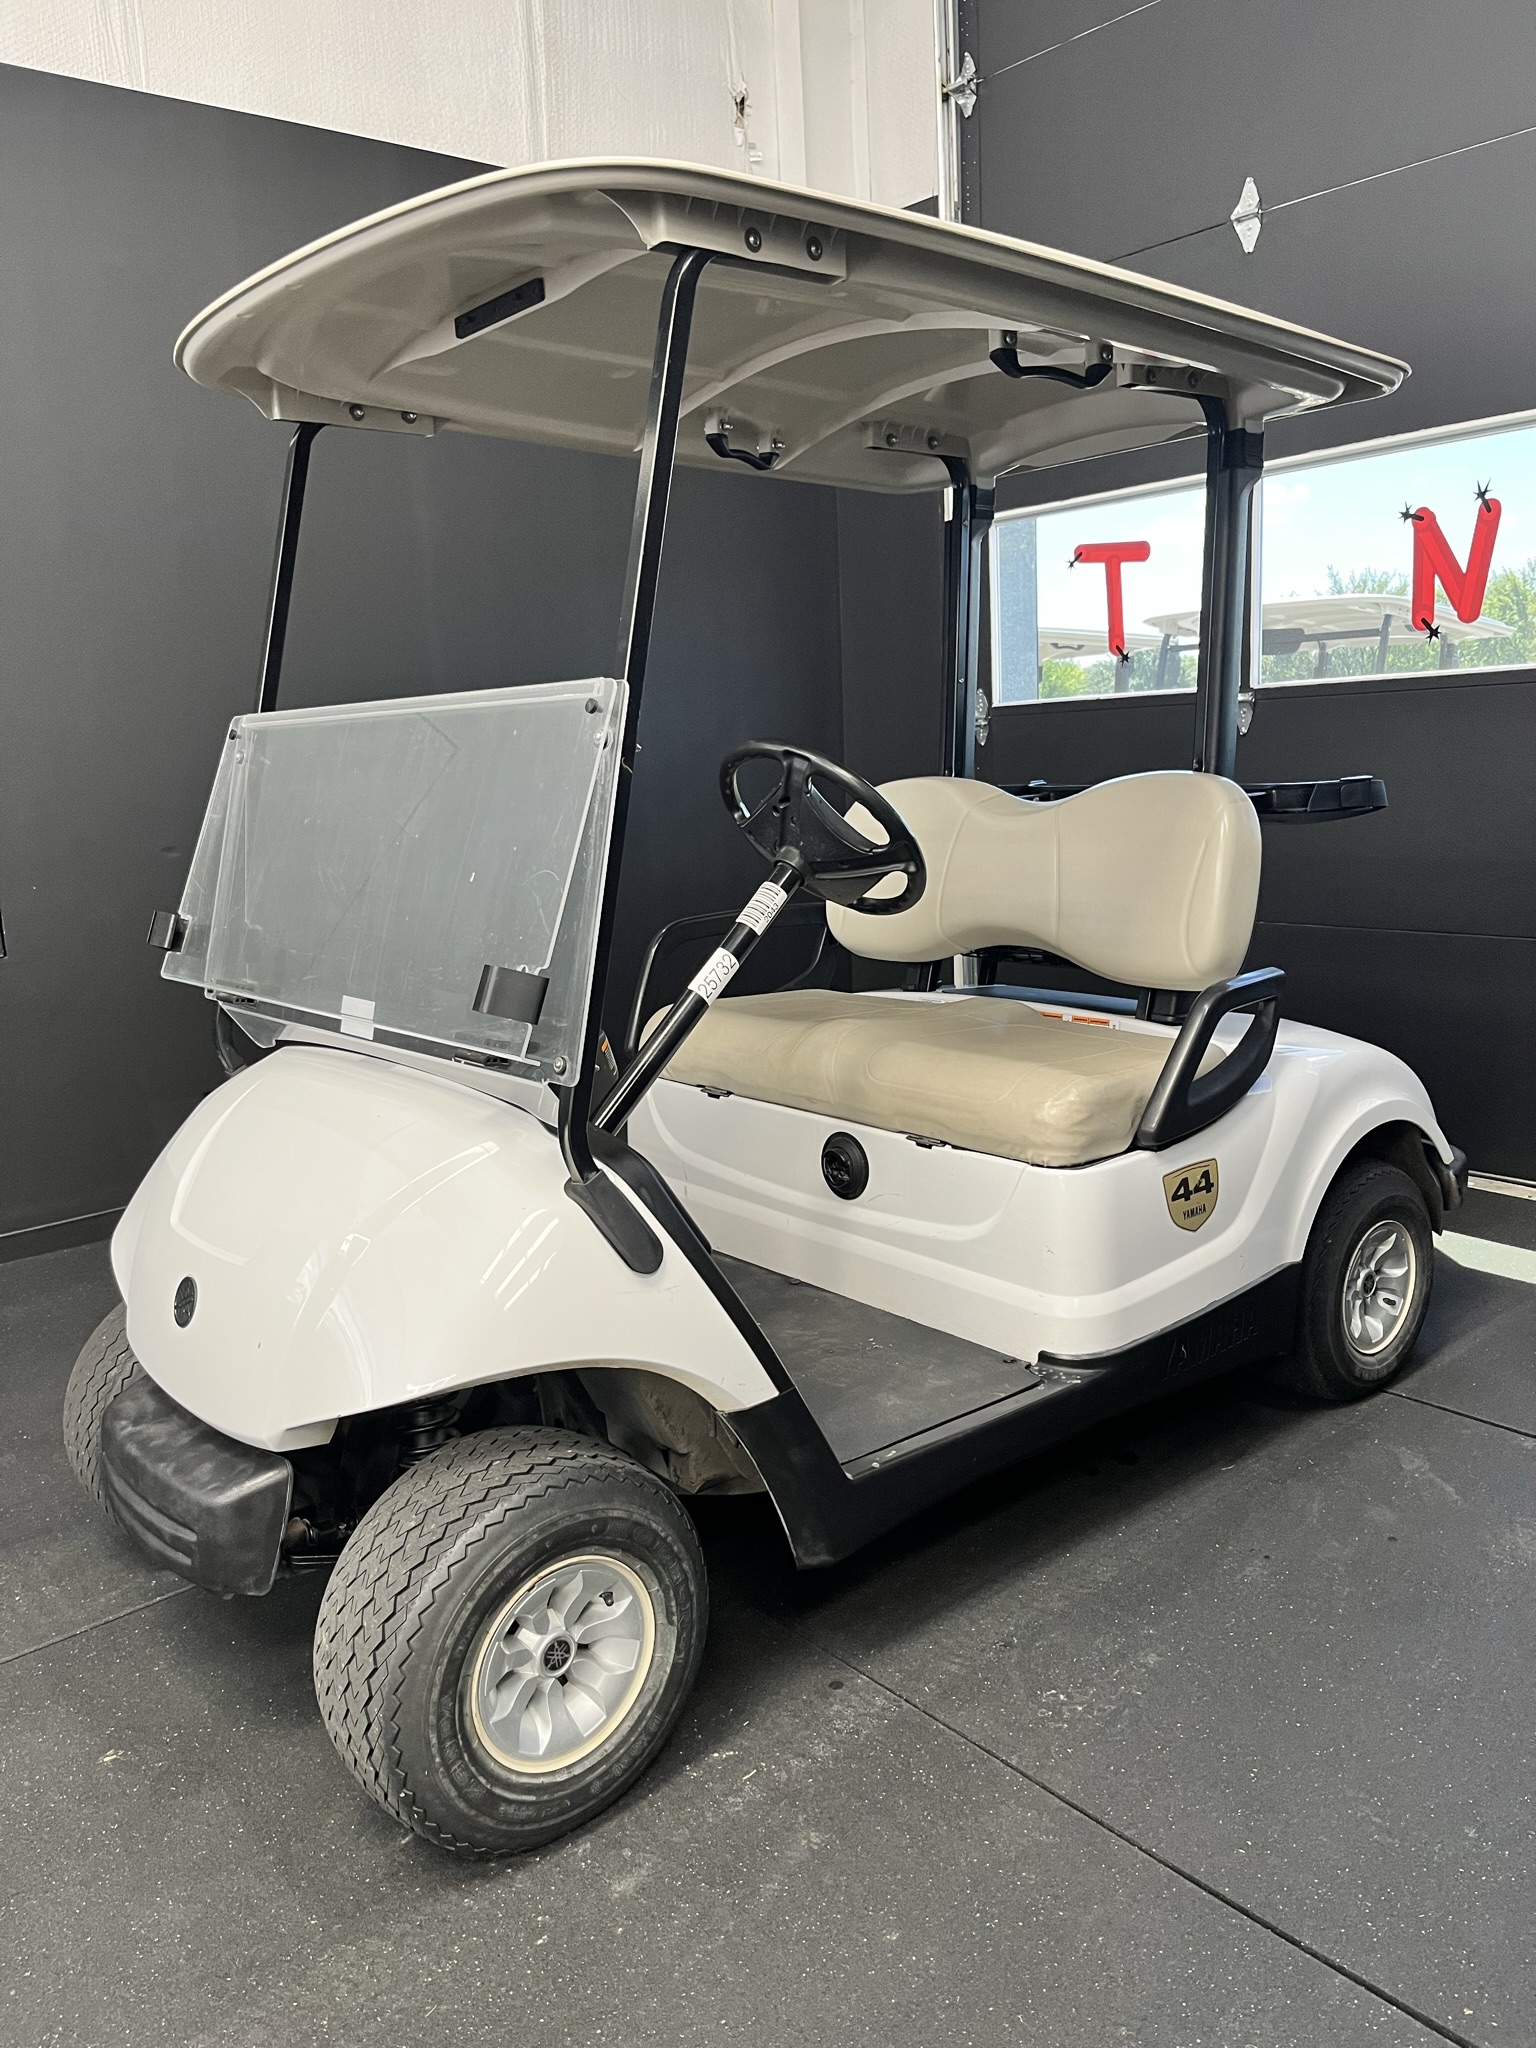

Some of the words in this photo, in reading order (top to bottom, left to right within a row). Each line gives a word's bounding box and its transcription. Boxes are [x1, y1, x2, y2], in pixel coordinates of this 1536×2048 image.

[1412, 498, 1502, 631] N
[1074, 541, 1151, 656] T
[697, 953, 737, 999] 25732
[1171, 1169, 1215, 1202] 44
[1182, 1203, 1207, 1221] YAMAHA
